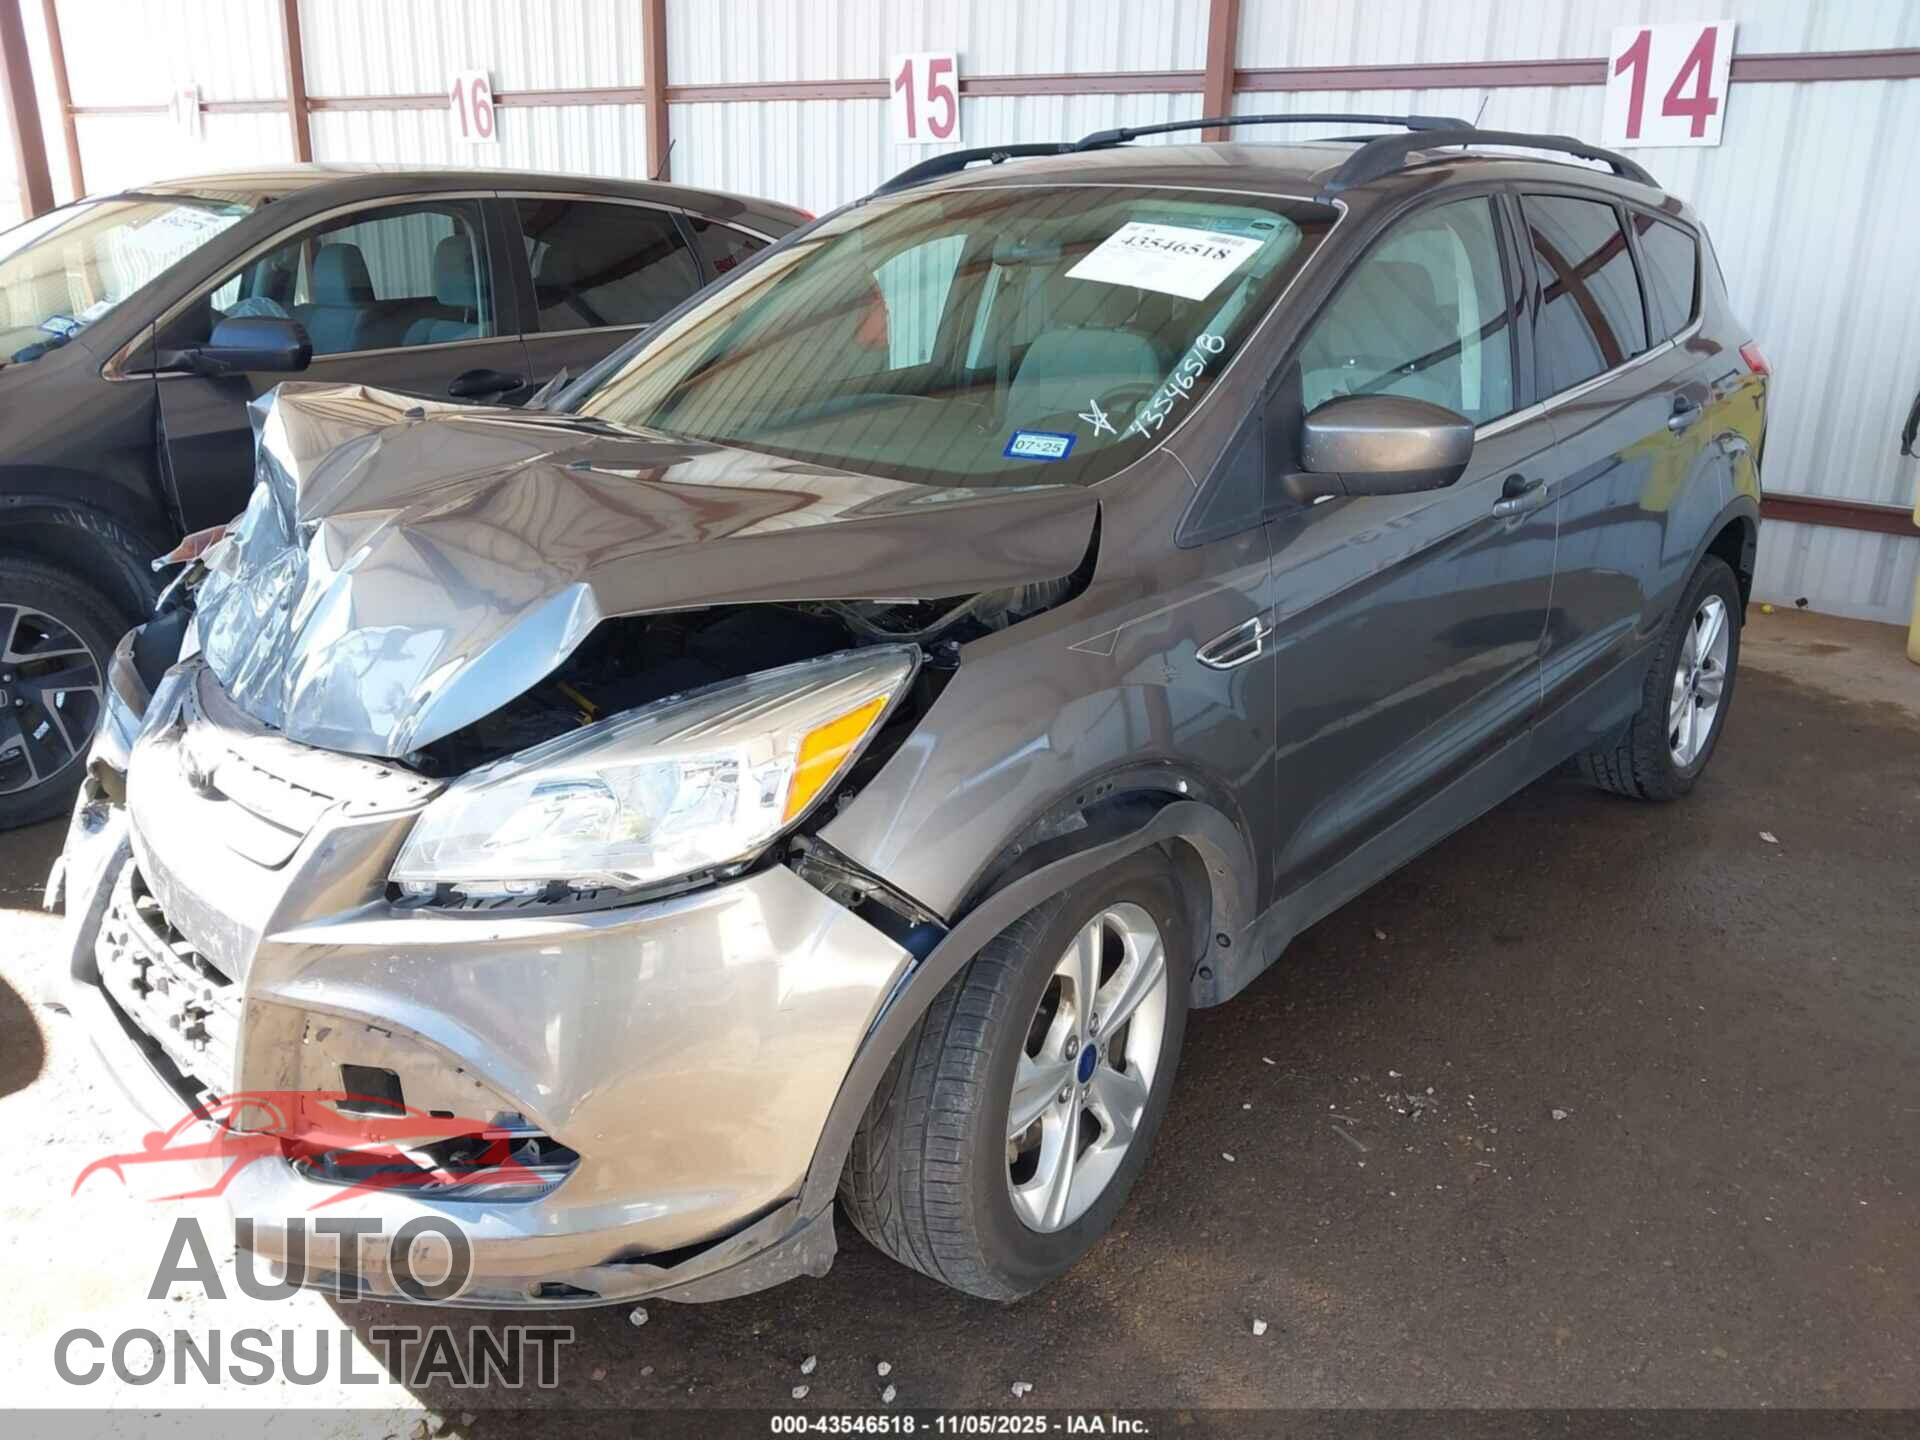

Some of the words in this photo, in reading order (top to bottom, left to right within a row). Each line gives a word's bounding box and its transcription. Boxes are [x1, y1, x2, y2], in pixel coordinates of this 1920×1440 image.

[451, 78, 493, 138] 16
[894, 58, 956, 139] 15
[1614, 26, 1719, 139] 14
[1120, 235, 1232, 261] 43546518
